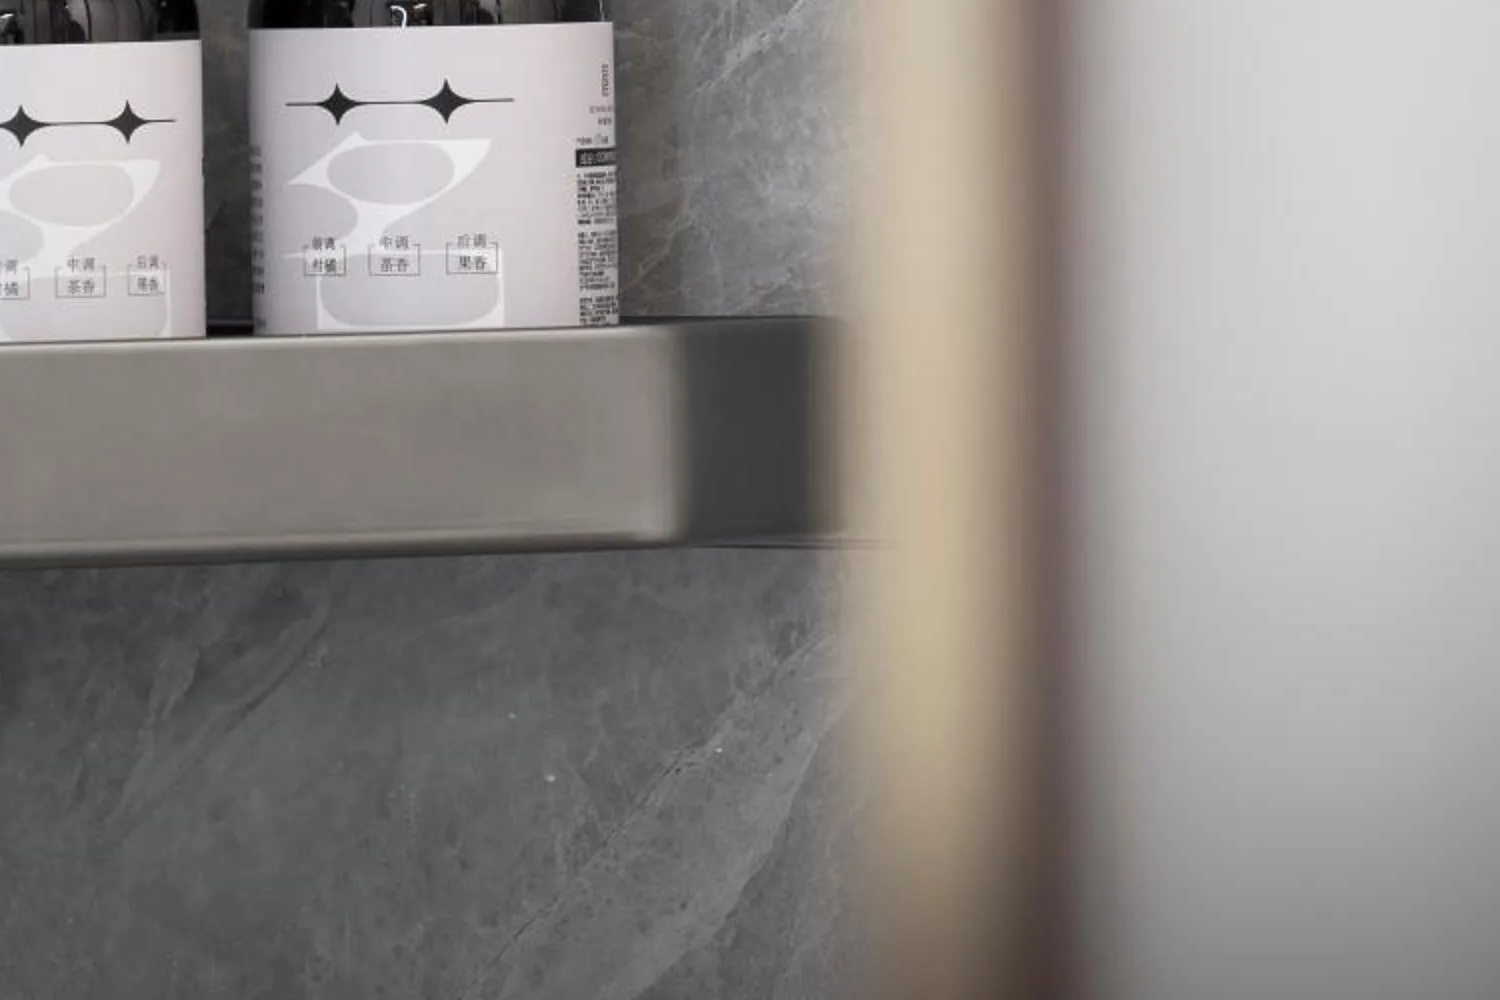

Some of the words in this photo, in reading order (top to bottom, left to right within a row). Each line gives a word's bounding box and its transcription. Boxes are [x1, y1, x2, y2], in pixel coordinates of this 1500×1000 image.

[379, 236, 409, 249] 中调
[67, 256, 95, 271] 中调
[380, 257, 409, 272] 茶香
[459, 255, 487, 271] 果香
[67, 279, 95, 295] 茶香
